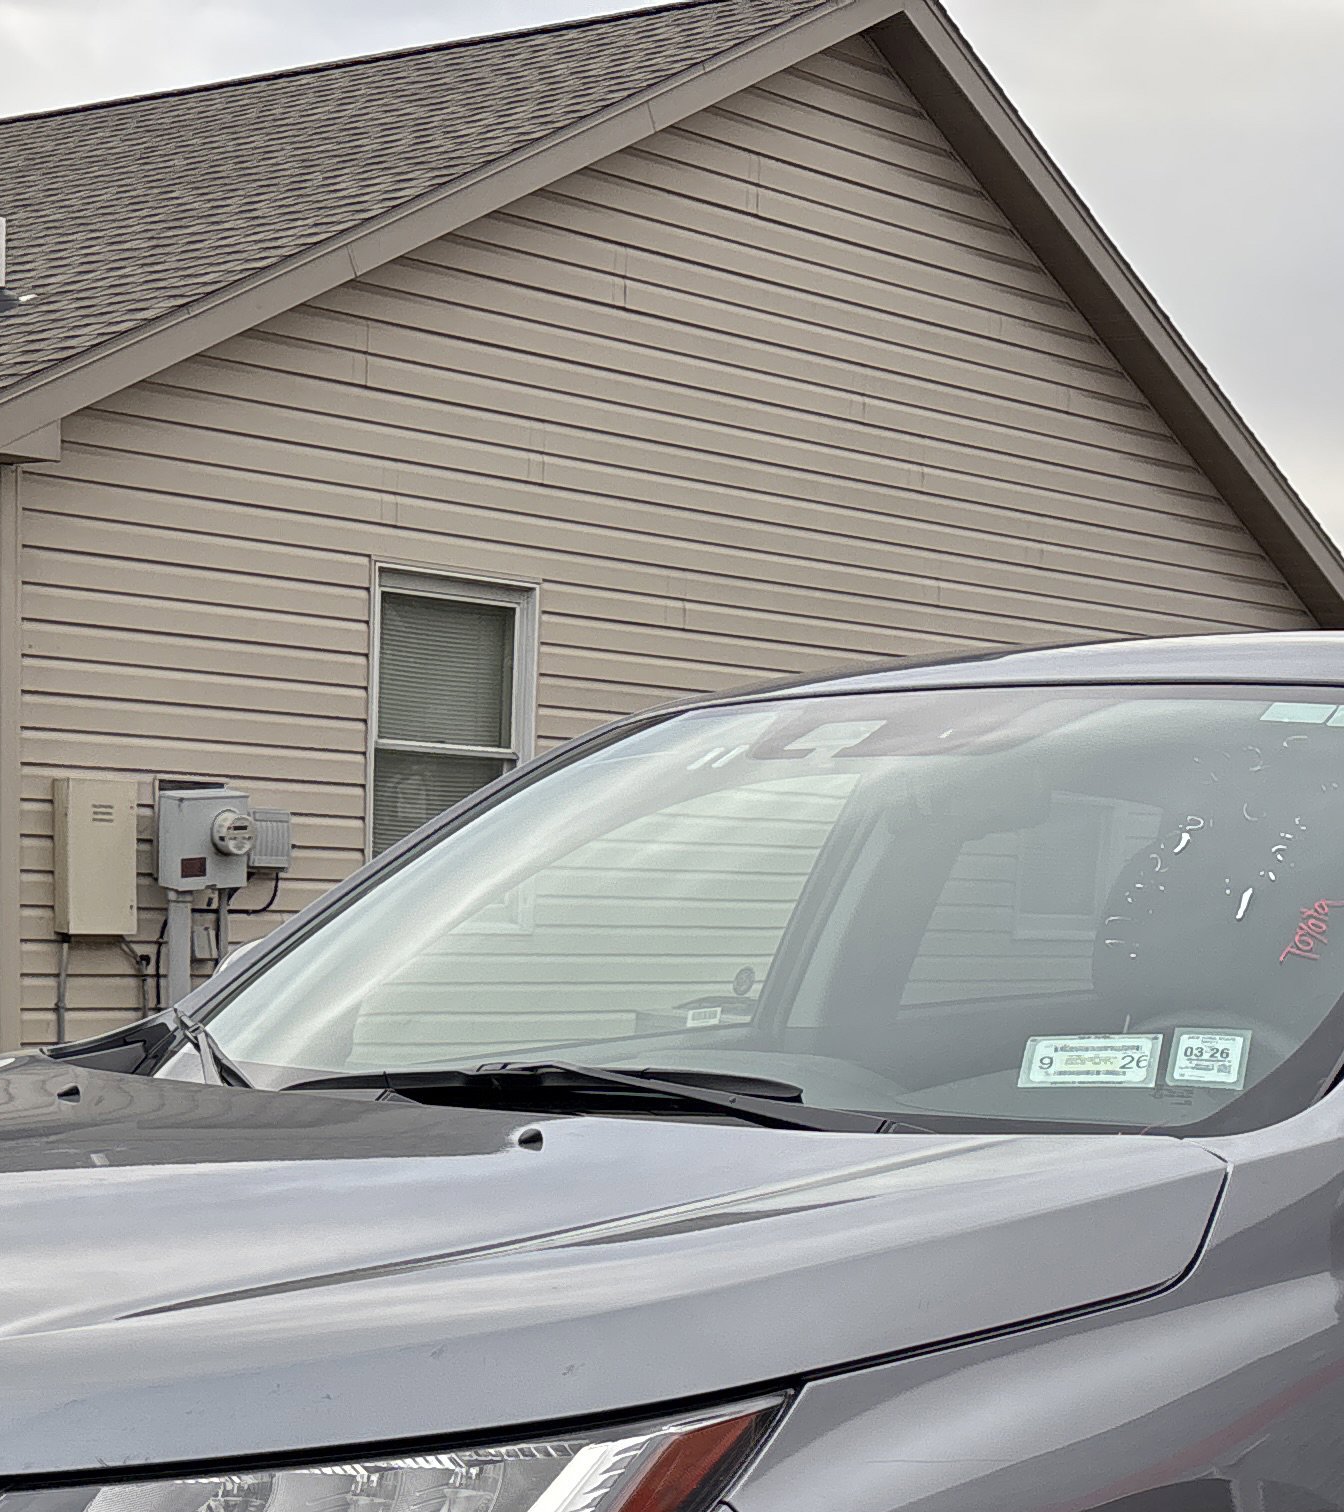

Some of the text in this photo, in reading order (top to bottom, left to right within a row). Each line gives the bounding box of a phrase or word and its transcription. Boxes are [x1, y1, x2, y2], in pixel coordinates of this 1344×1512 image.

[1183, 1046, 1231, 1060] 03 26
[1038, 1056, 1054, 1070] 9
